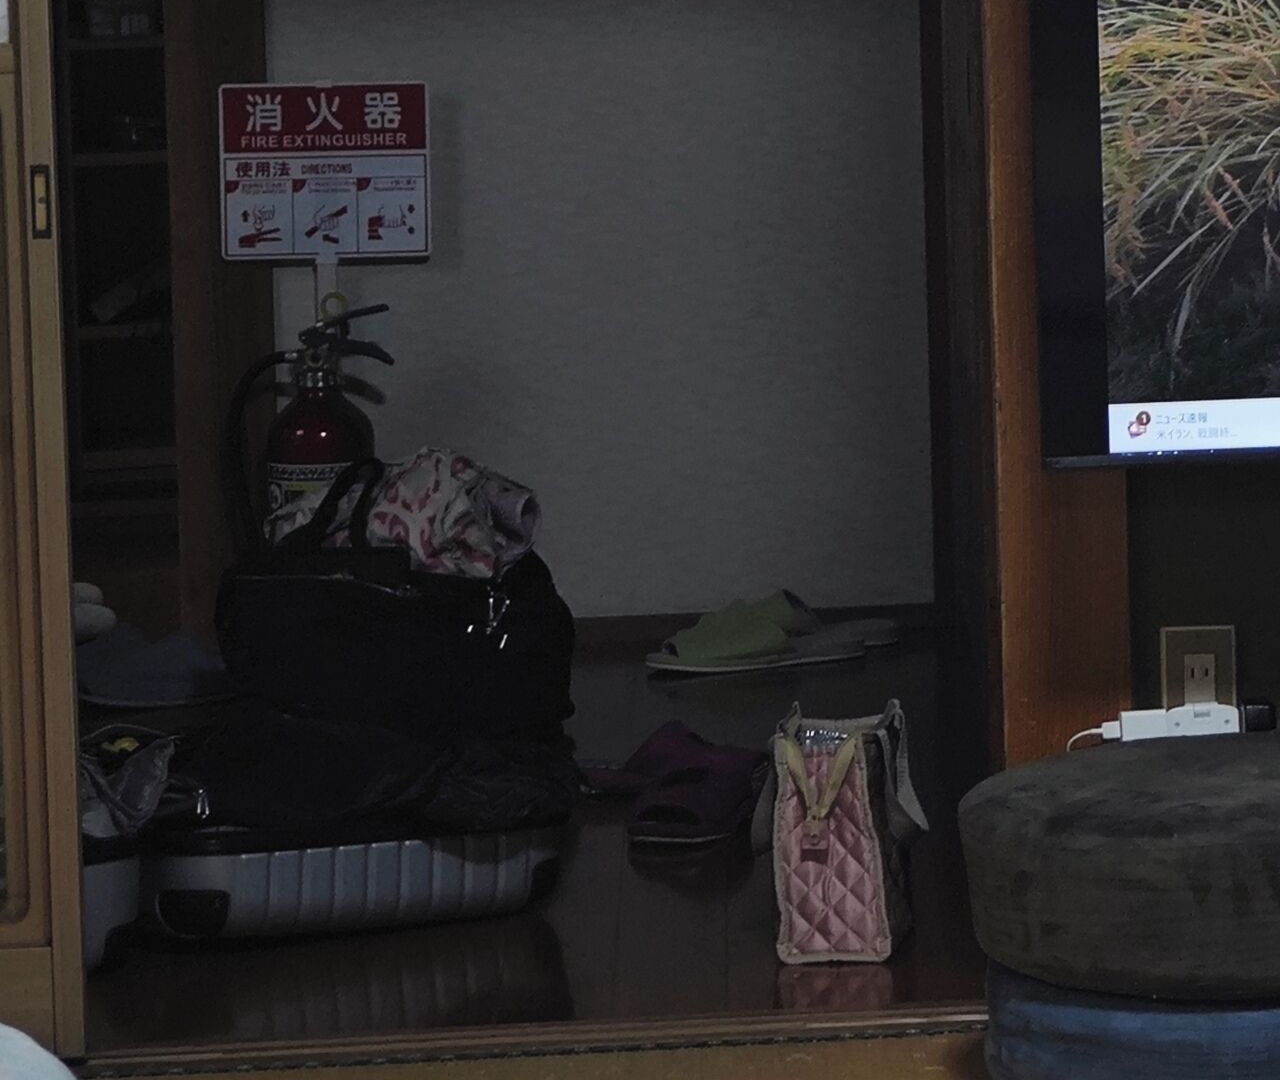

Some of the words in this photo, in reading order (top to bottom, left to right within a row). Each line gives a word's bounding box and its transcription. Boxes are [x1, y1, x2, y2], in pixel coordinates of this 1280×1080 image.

[246, 92, 402, 132] 消火器
[241, 135, 282, 148] FIRE
[283, 133, 407, 147] EXTINGUISHER
[236, 161, 291, 178] 使用法
[301, 163, 352, 175] DIRECTIONS
